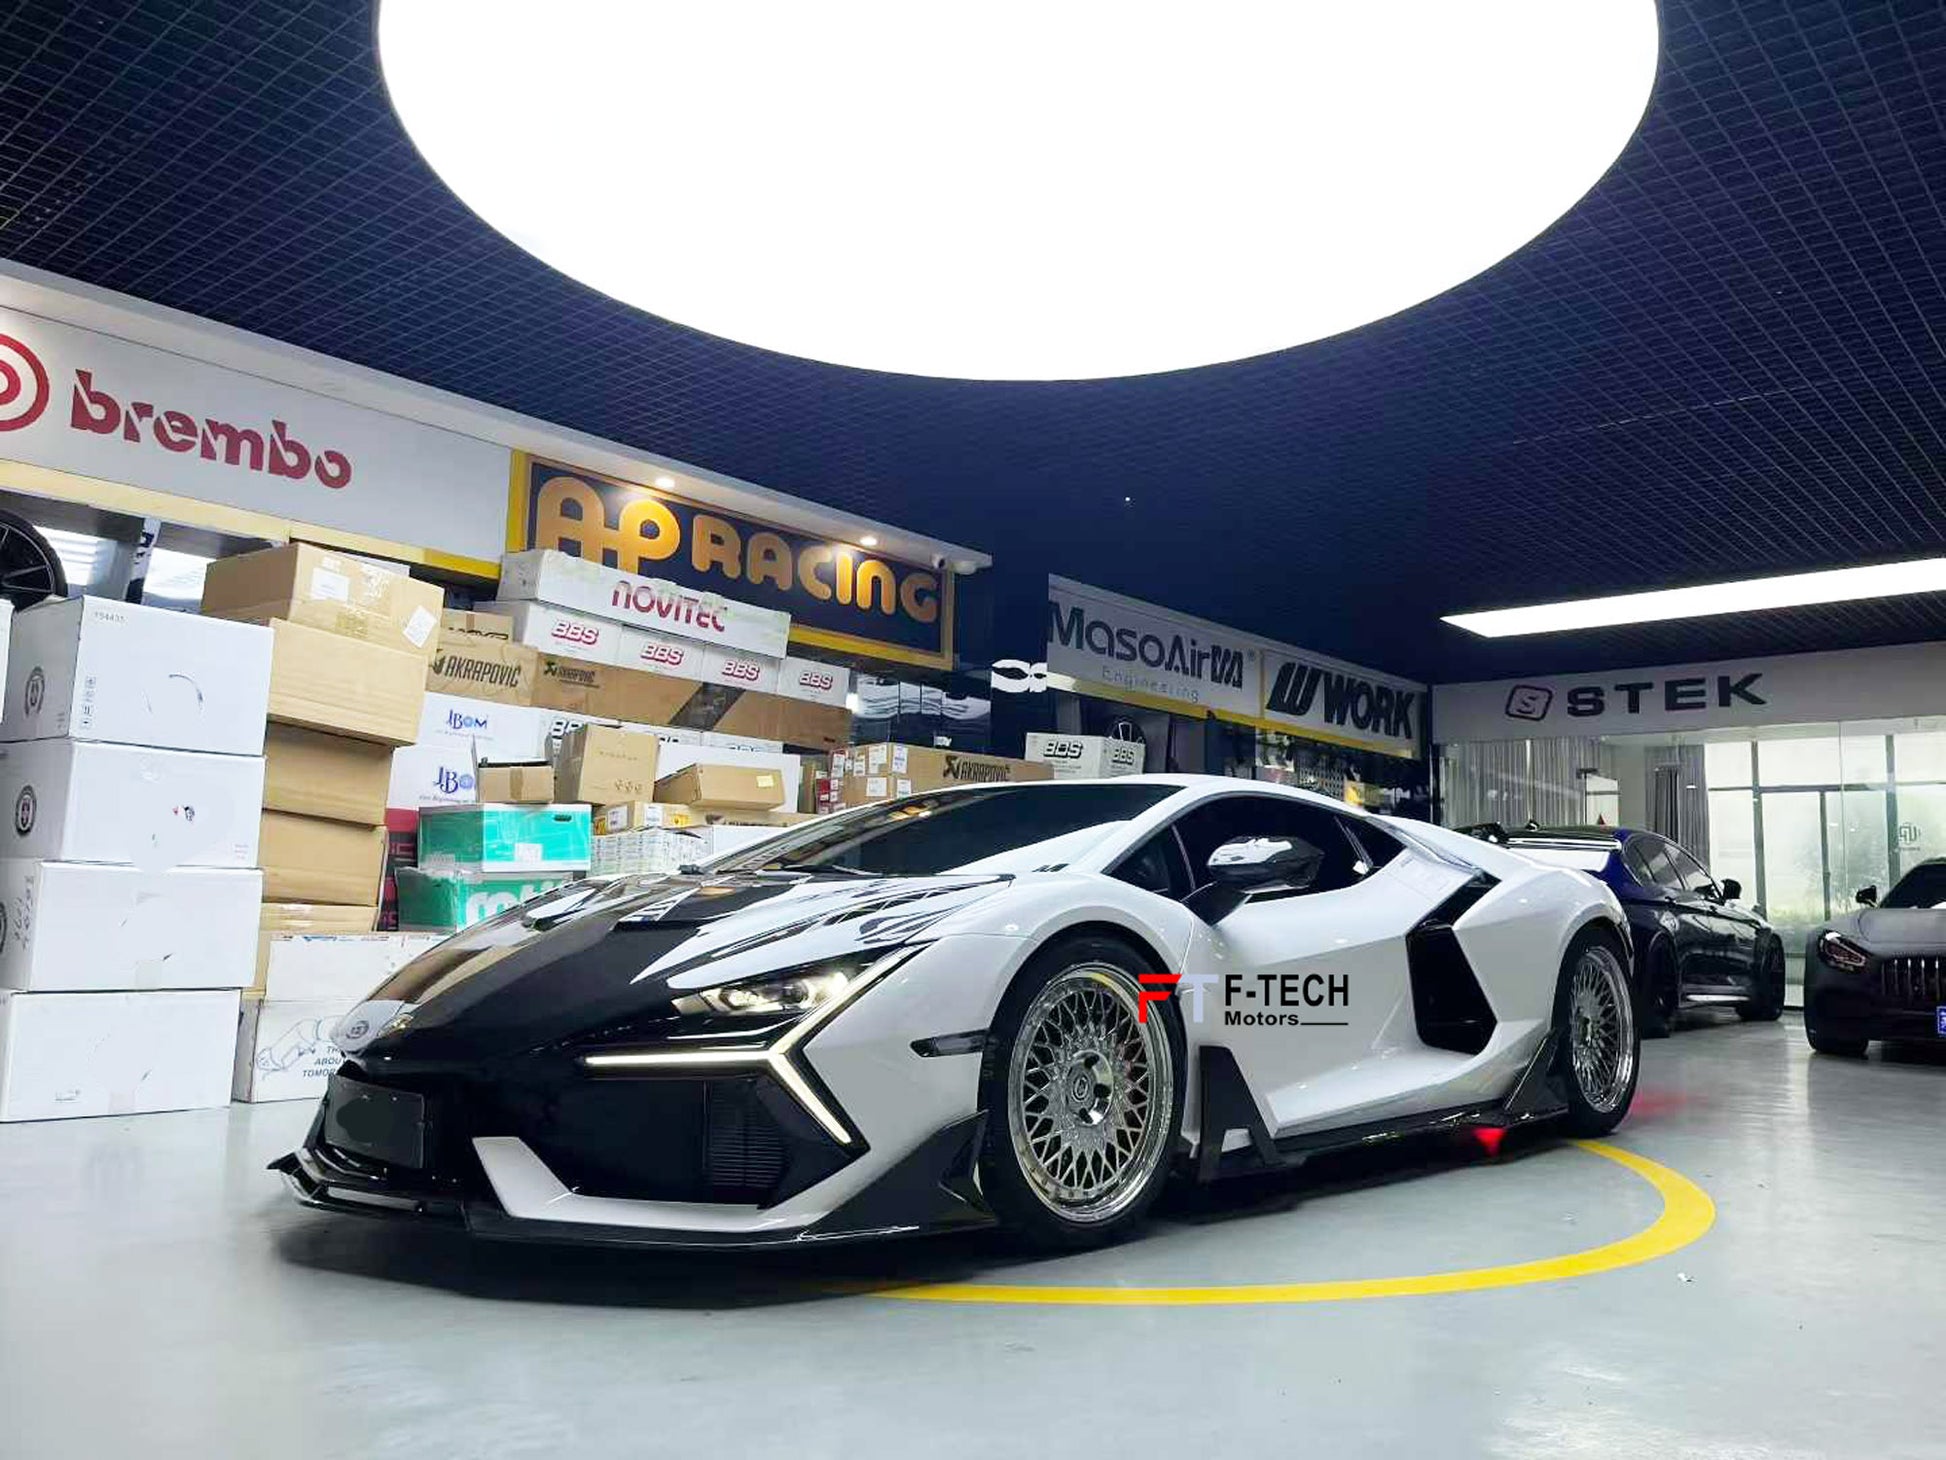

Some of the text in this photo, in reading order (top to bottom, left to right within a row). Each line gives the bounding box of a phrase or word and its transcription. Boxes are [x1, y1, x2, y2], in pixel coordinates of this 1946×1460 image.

[70, 368, 353, 489] brembo
[536, 476, 939, 623] AP RACING
[611, 580, 727, 632] NOVITEC
[551, 619, 599, 645] BBS
[640, 642, 684, 665] BBS
[721, 660, 760, 681] BBS
[799, 670, 833, 690] BBS
[1323, 671, 1415, 740] WORK
[1566, 672, 1768, 718] STEK
